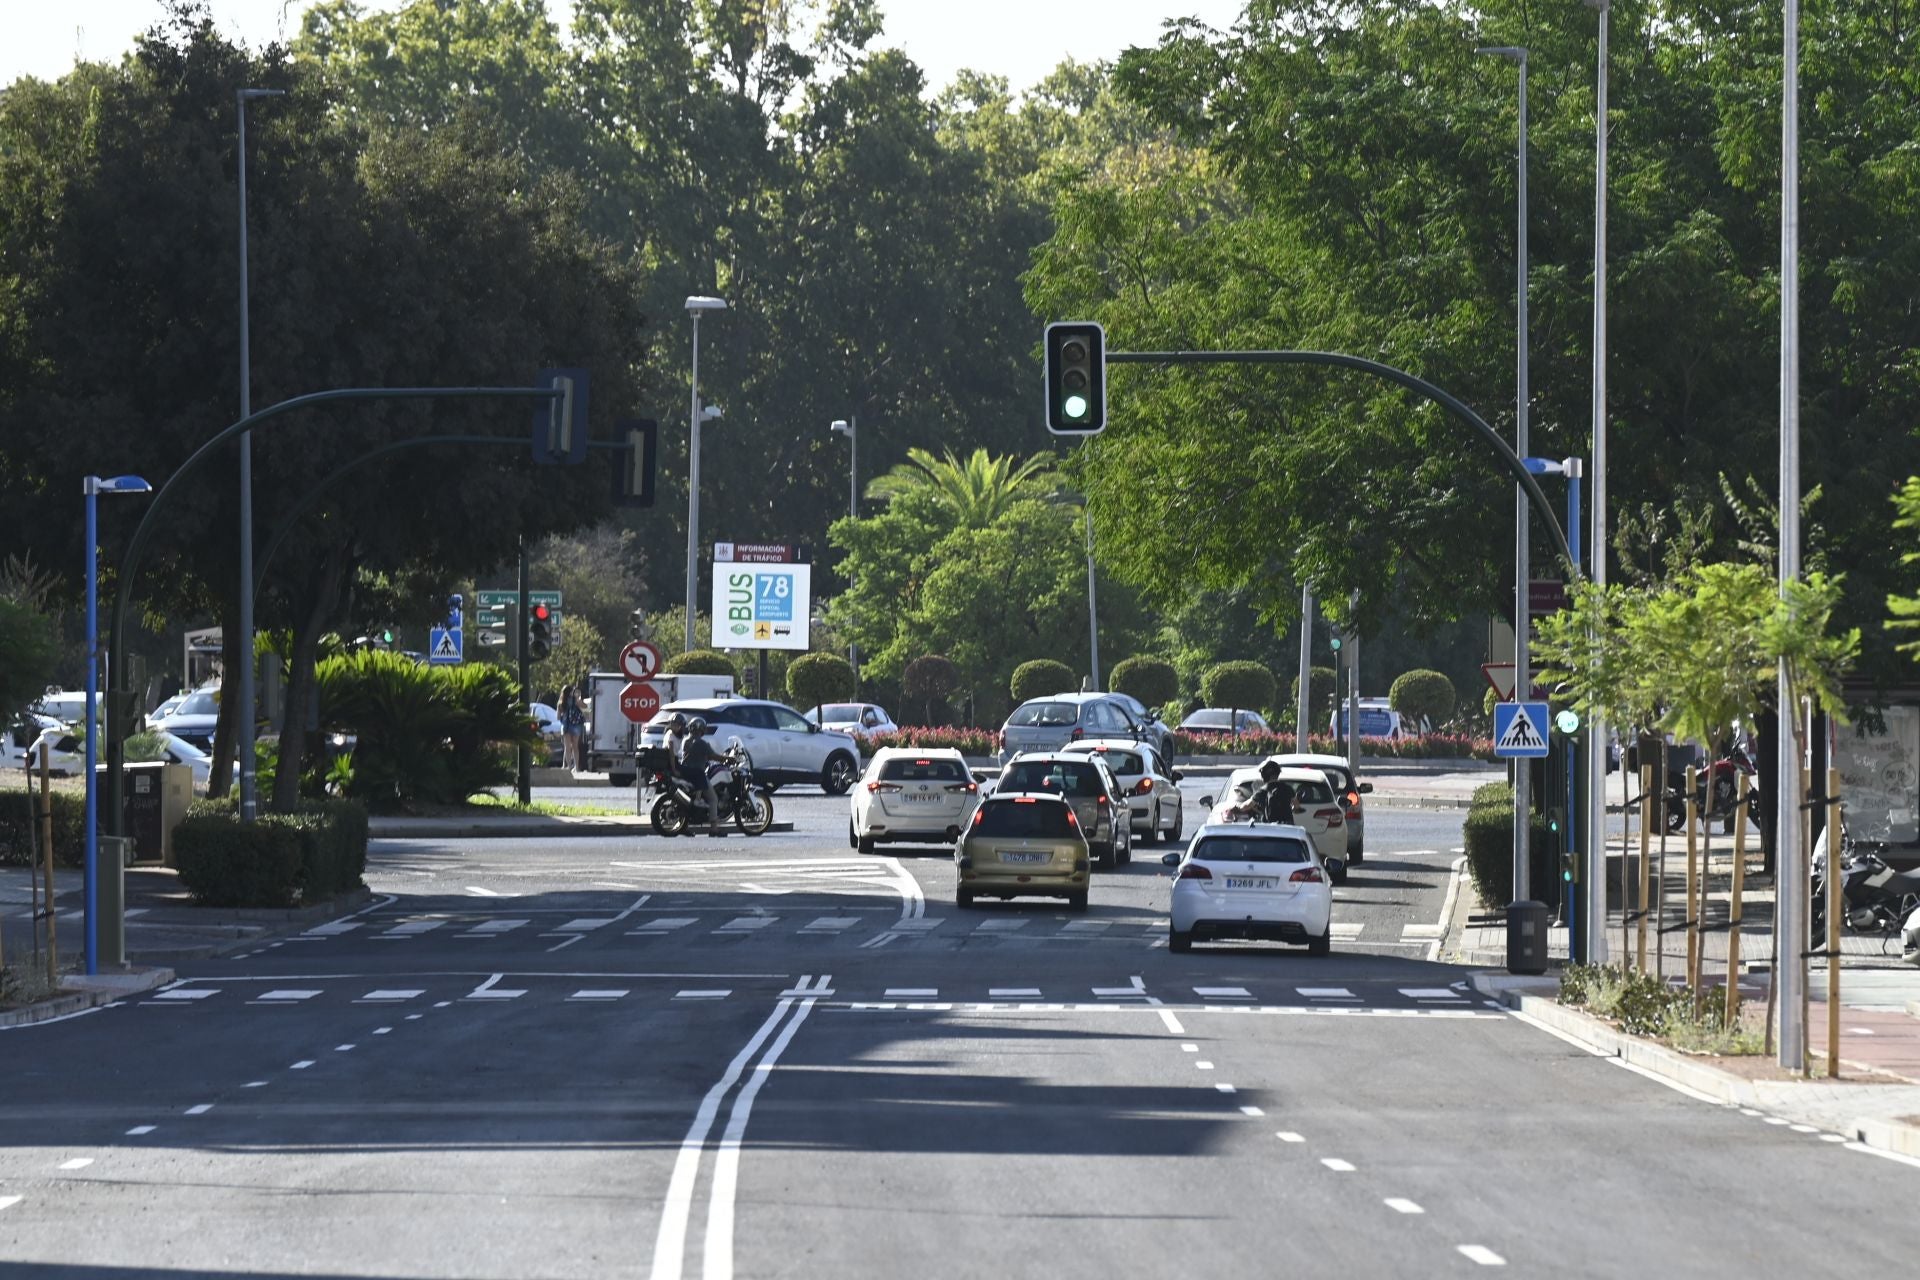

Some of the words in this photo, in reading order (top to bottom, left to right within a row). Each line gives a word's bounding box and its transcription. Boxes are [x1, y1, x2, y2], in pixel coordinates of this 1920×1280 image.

[738, 545, 785, 553] INFORMACIÓN
[742, 554, 751, 562] DE
[753, 553, 782, 562] TRÁFICO
[760, 575, 789, 599] 78
[729, 574, 753, 621] BUS
[624, 697, 657, 709] STOP
[1256, 880, 1272, 889] JFL
